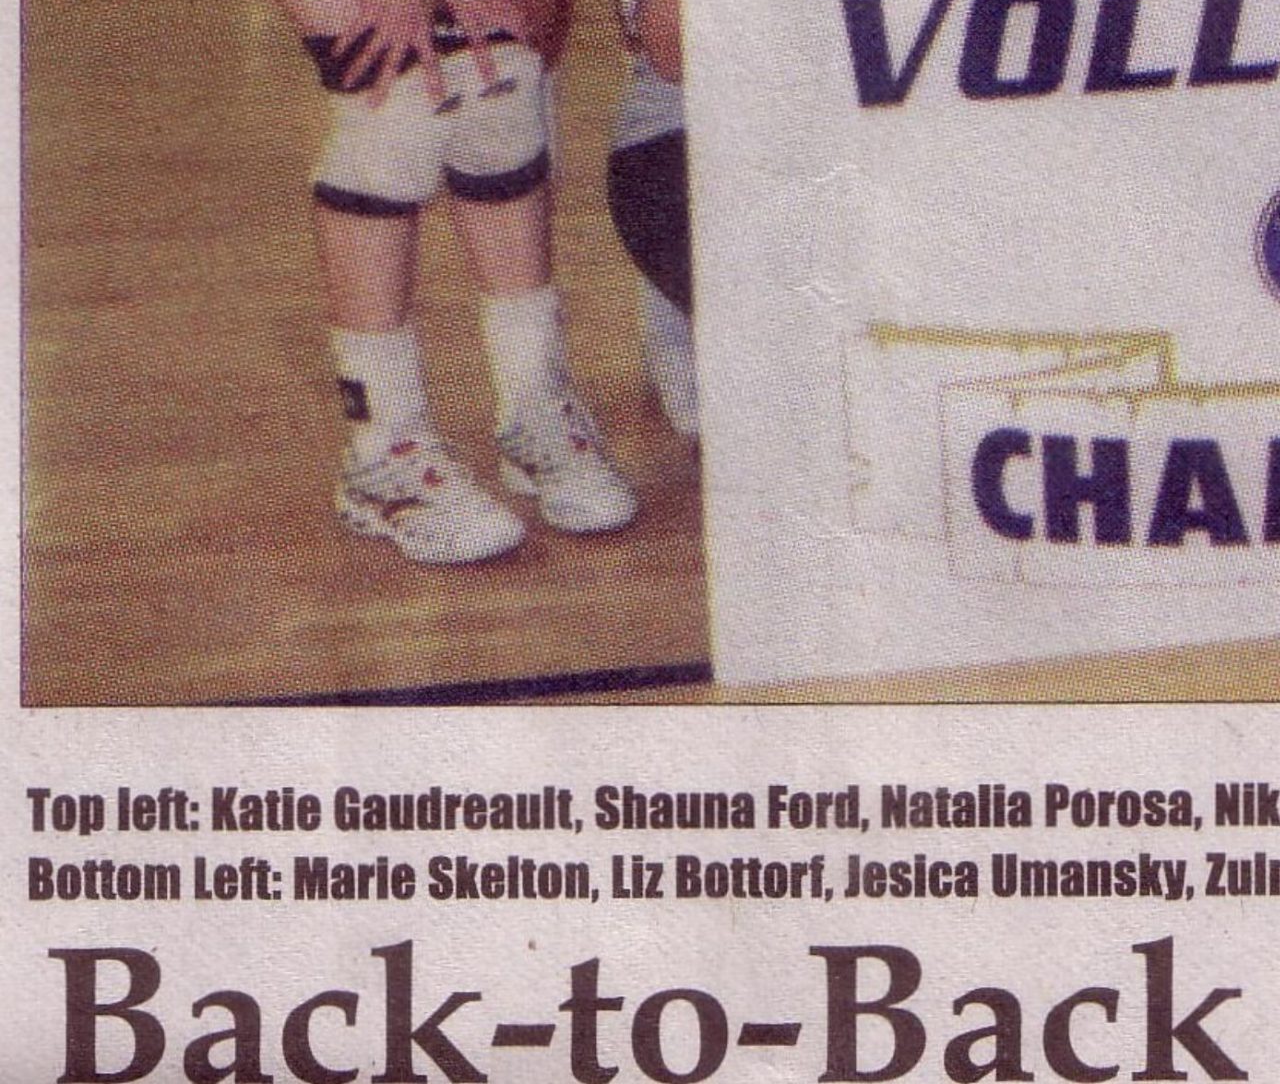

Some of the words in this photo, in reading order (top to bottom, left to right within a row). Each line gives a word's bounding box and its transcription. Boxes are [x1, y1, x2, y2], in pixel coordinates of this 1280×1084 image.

[27, 788, 104, 835] Top
[118, 788, 199, 831] left:
[212, 788, 321, 831] Katie
[335, 787, 582, 833] Gaudreault,
[596, 786, 754, 830] Shauna
[768, 785, 869, 832] Ford,
[882, 785, 1031, 828] Natalia
[1046, 784, 1202, 830] Porosa,
[29, 858, 180, 900] Bottom
[195, 857, 281, 900] Left:
[294, 857, 415, 900] Marie
[429, 856, 598, 902] Skelton,
[613, 856, 663, 898] Liz
[676, 855, 833, 901] Bottorf,
[845, 855, 978, 898] Jesica
[992, 854, 1194, 900] Umansky,
[48, 936, 1249, 1084] Back-to-Back
